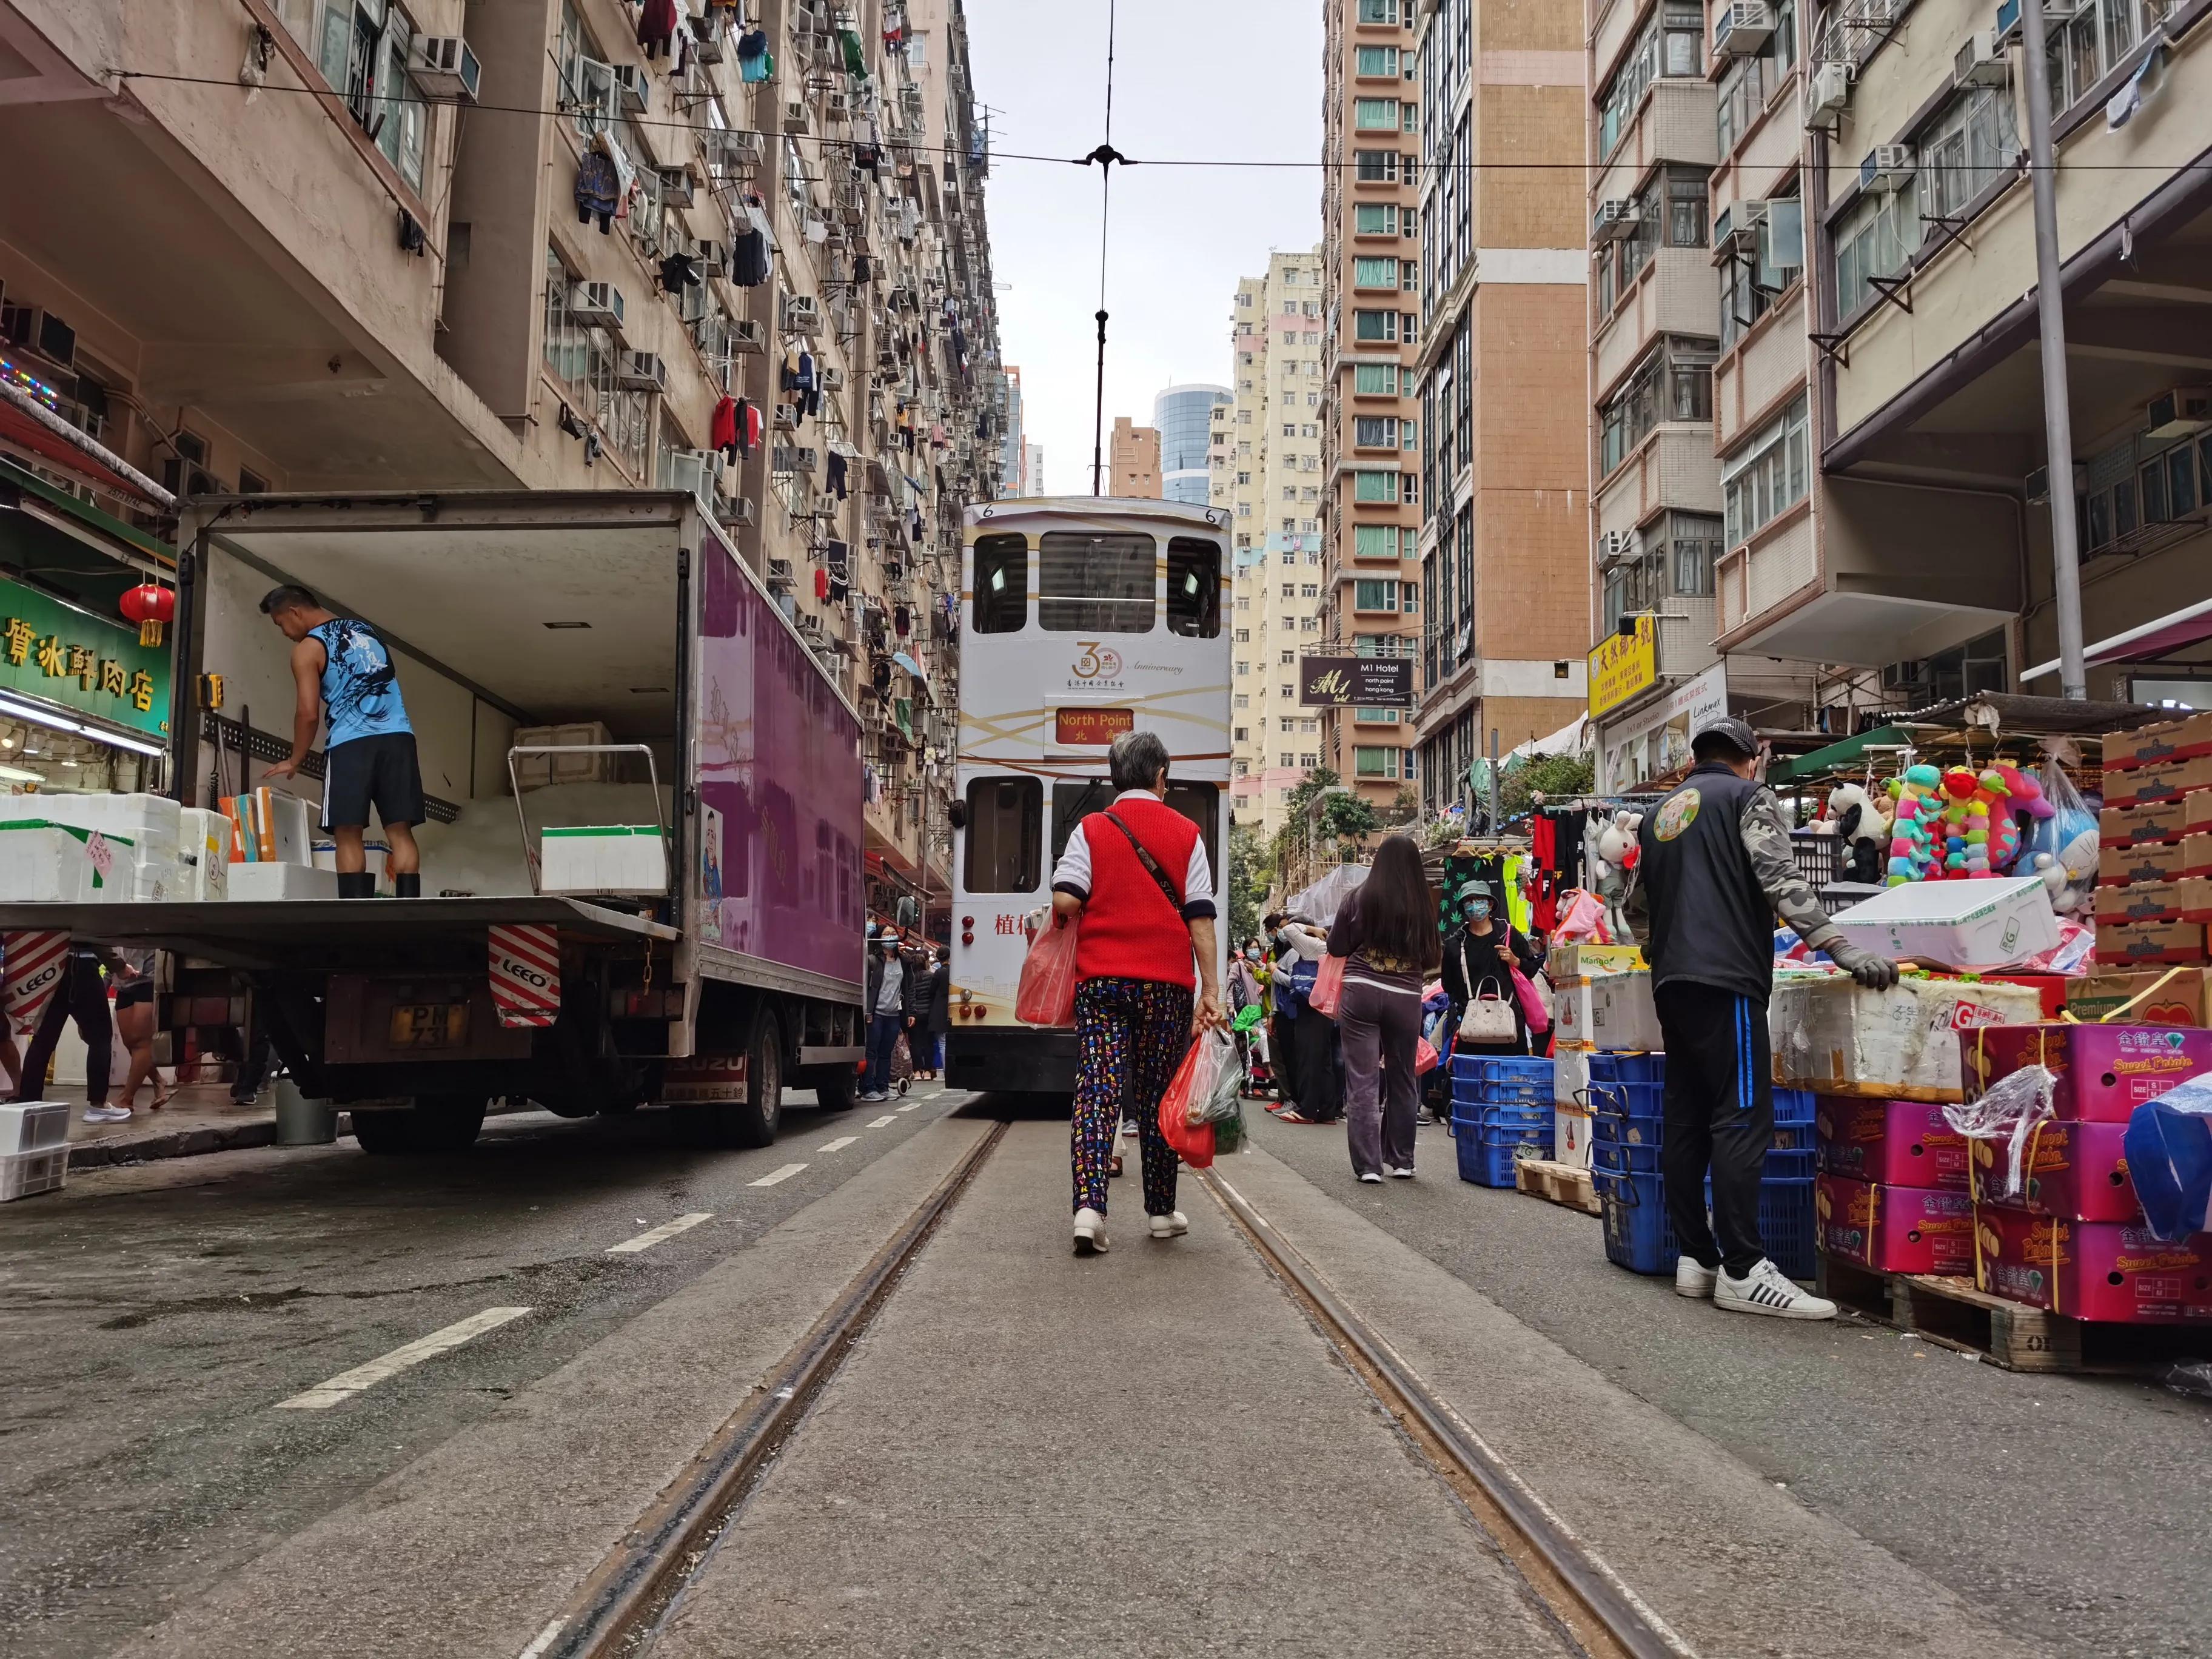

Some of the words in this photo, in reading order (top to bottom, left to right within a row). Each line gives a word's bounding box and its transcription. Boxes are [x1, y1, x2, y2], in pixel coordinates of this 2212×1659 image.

[983, 504, 993, 517] 6
[1205, 509, 1216, 523] 6
[1127, 661, 1183, 675] Anniversary
[1059, 714, 1094, 725] North
[1100, 714, 1132, 726] Point
[1581, 957, 1609, 966] Mango
[503, 959, 546, 987] LEEO
[16, 967, 56, 996] LEEO
[2071, 1000, 2116, 1015] Premium
[1955, 1005, 1973, 1028] G
[2117, 1031, 2167, 1047] 金鑽皇
[2114, 1057, 2153, 1071] Sweet
[2153, 1056, 2193, 1068] Potato
